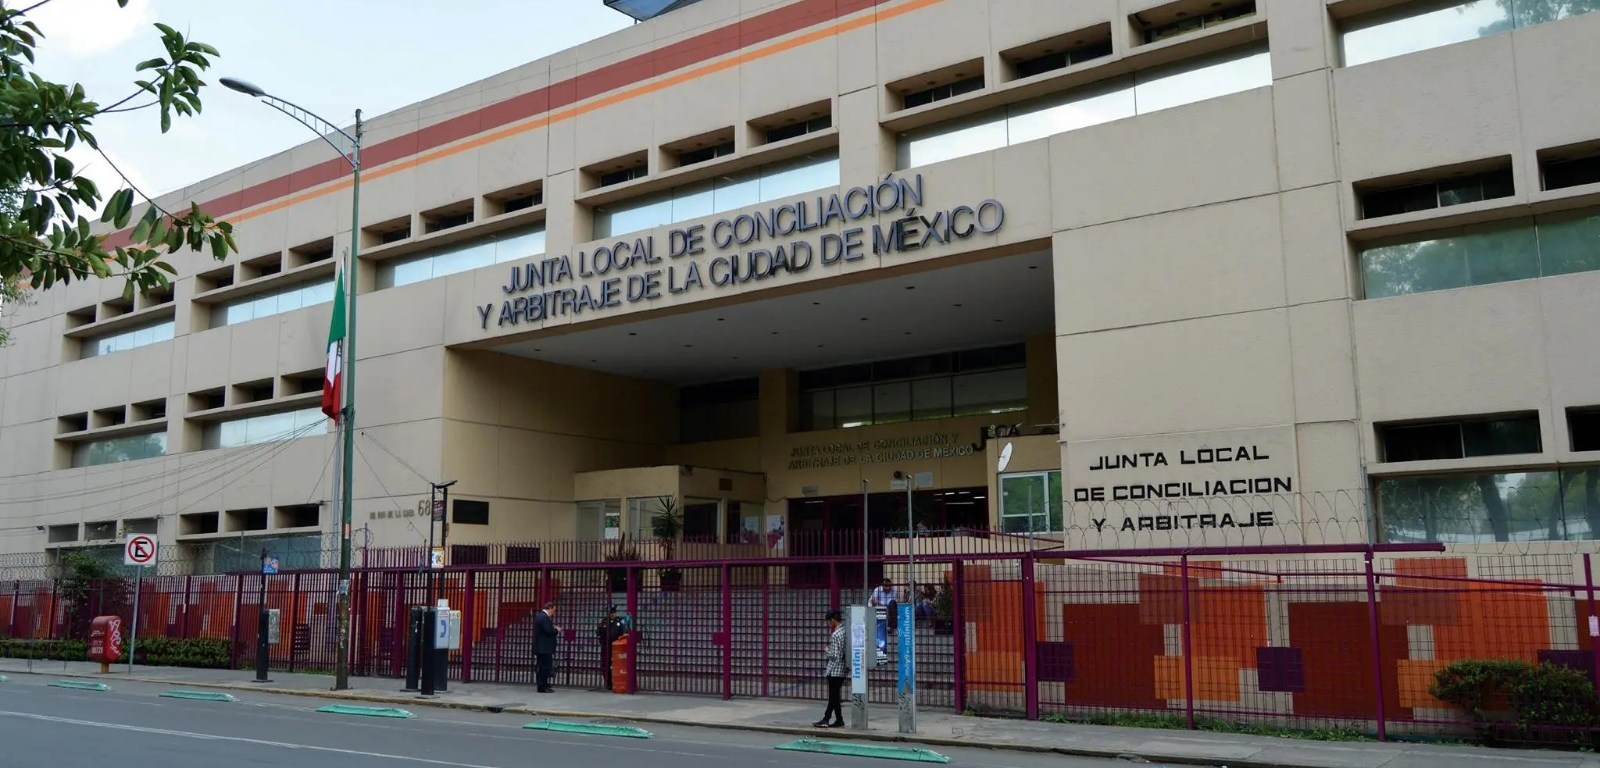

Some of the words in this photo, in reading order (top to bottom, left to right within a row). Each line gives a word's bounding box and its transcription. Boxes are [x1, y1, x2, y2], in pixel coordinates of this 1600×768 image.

[502, 253, 573, 294] JUNTA
[579, 235, 661, 277] LOCAL
[668, 224, 704, 258] DE
[711, 173, 923, 247] CONCILIACIÓN
[476, 304, 495, 330] Y
[498, 274, 621, 325] ARBITRAJE
[627, 268, 661, 302] DE
[668, 259, 702, 293] LA
[709, 242, 812, 287] CIUDAD
[820, 228, 864, 264] DE
[872, 198, 1005, 255] MÉXICO
[788, 455, 840, 470] ARBITRAJE
[843, 455, 857, 466] DE
[860, 453, 873, 464] LA
[877, 449, 914, 463] CIUDAD
[918, 448, 931, 459] DE
[933, 444, 974, 458] MÉXICO
[790, 444, 820, 457] JUNTA
[823, 441, 854, 454] LOCAL
[857, 440, 870, 452] DE
[1090, 452, 1168, 470] JUNTA
[1180, 446, 1270, 464] LOCAL
[1074, 487, 1105, 502] DE
[1112, 477, 1292, 500] CONCILIACION
[1092, 518, 1107, 532] Y
[1121, 511, 1274, 531] ARBITRAJE
[135, 541, 148, 557] E
